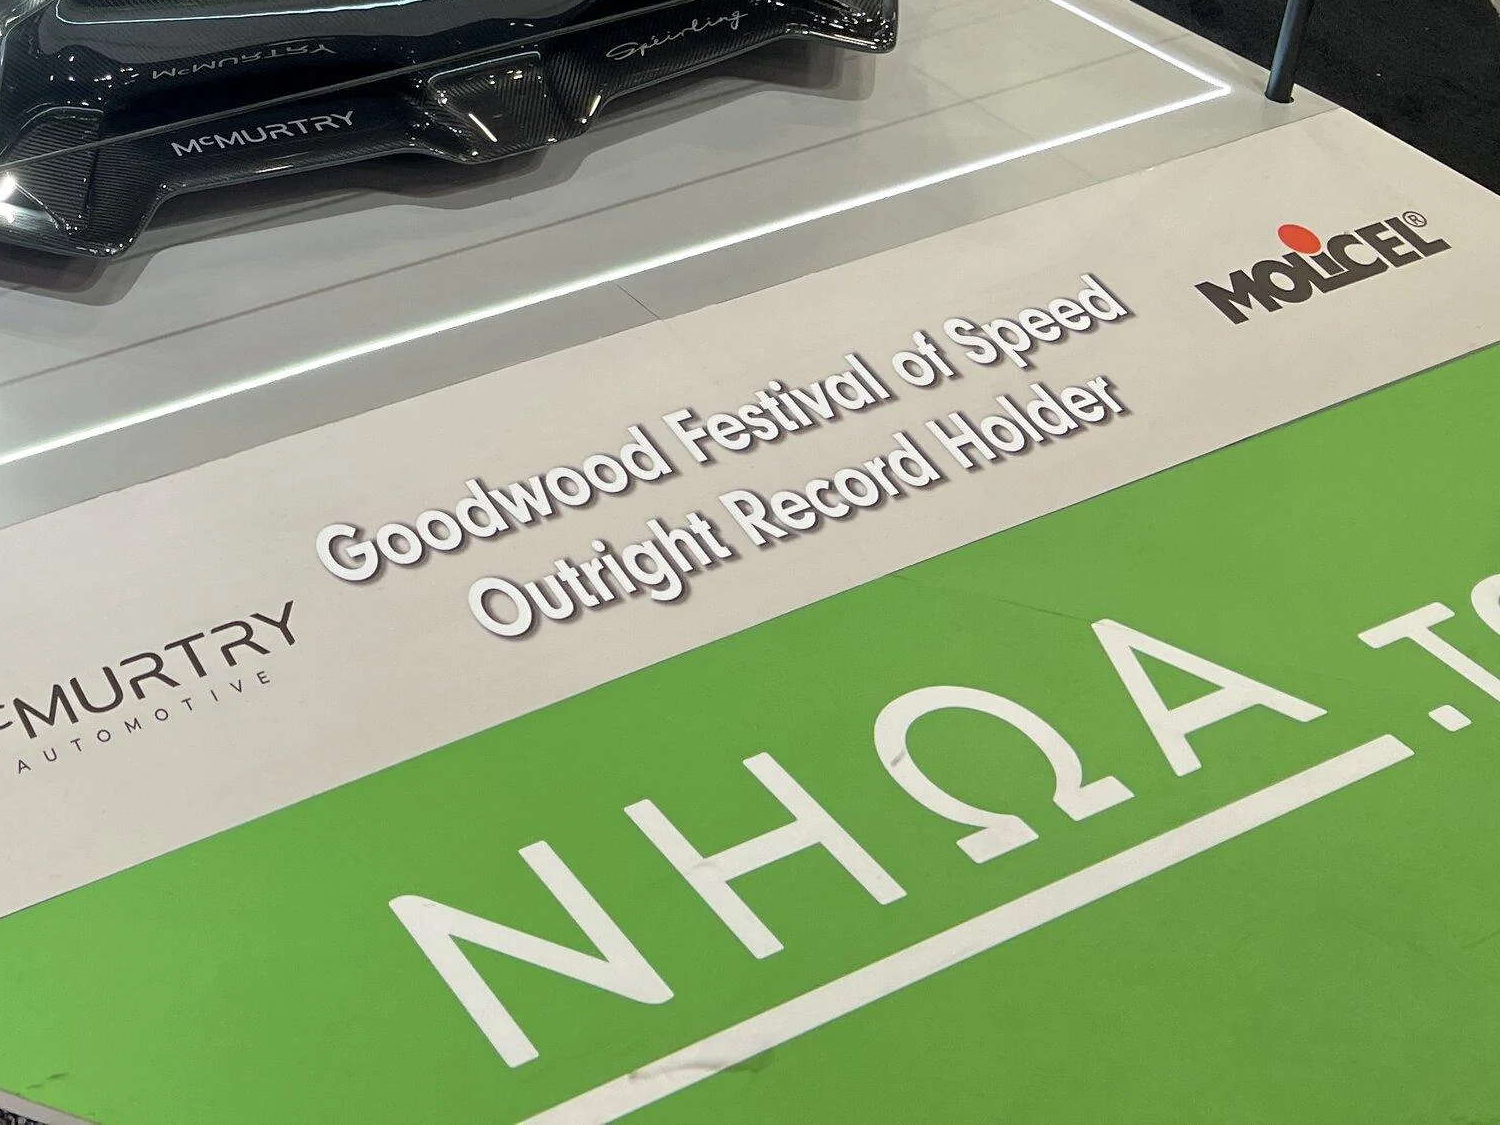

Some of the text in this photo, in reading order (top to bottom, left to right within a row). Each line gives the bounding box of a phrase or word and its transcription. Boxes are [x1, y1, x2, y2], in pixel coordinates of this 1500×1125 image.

[316, 275, 1131, 585] Goodwood Festival of Speed
[468, 373, 1128, 639] Outright Record Holder
[16, 669, 272, 775] AUTOMOTIVE
